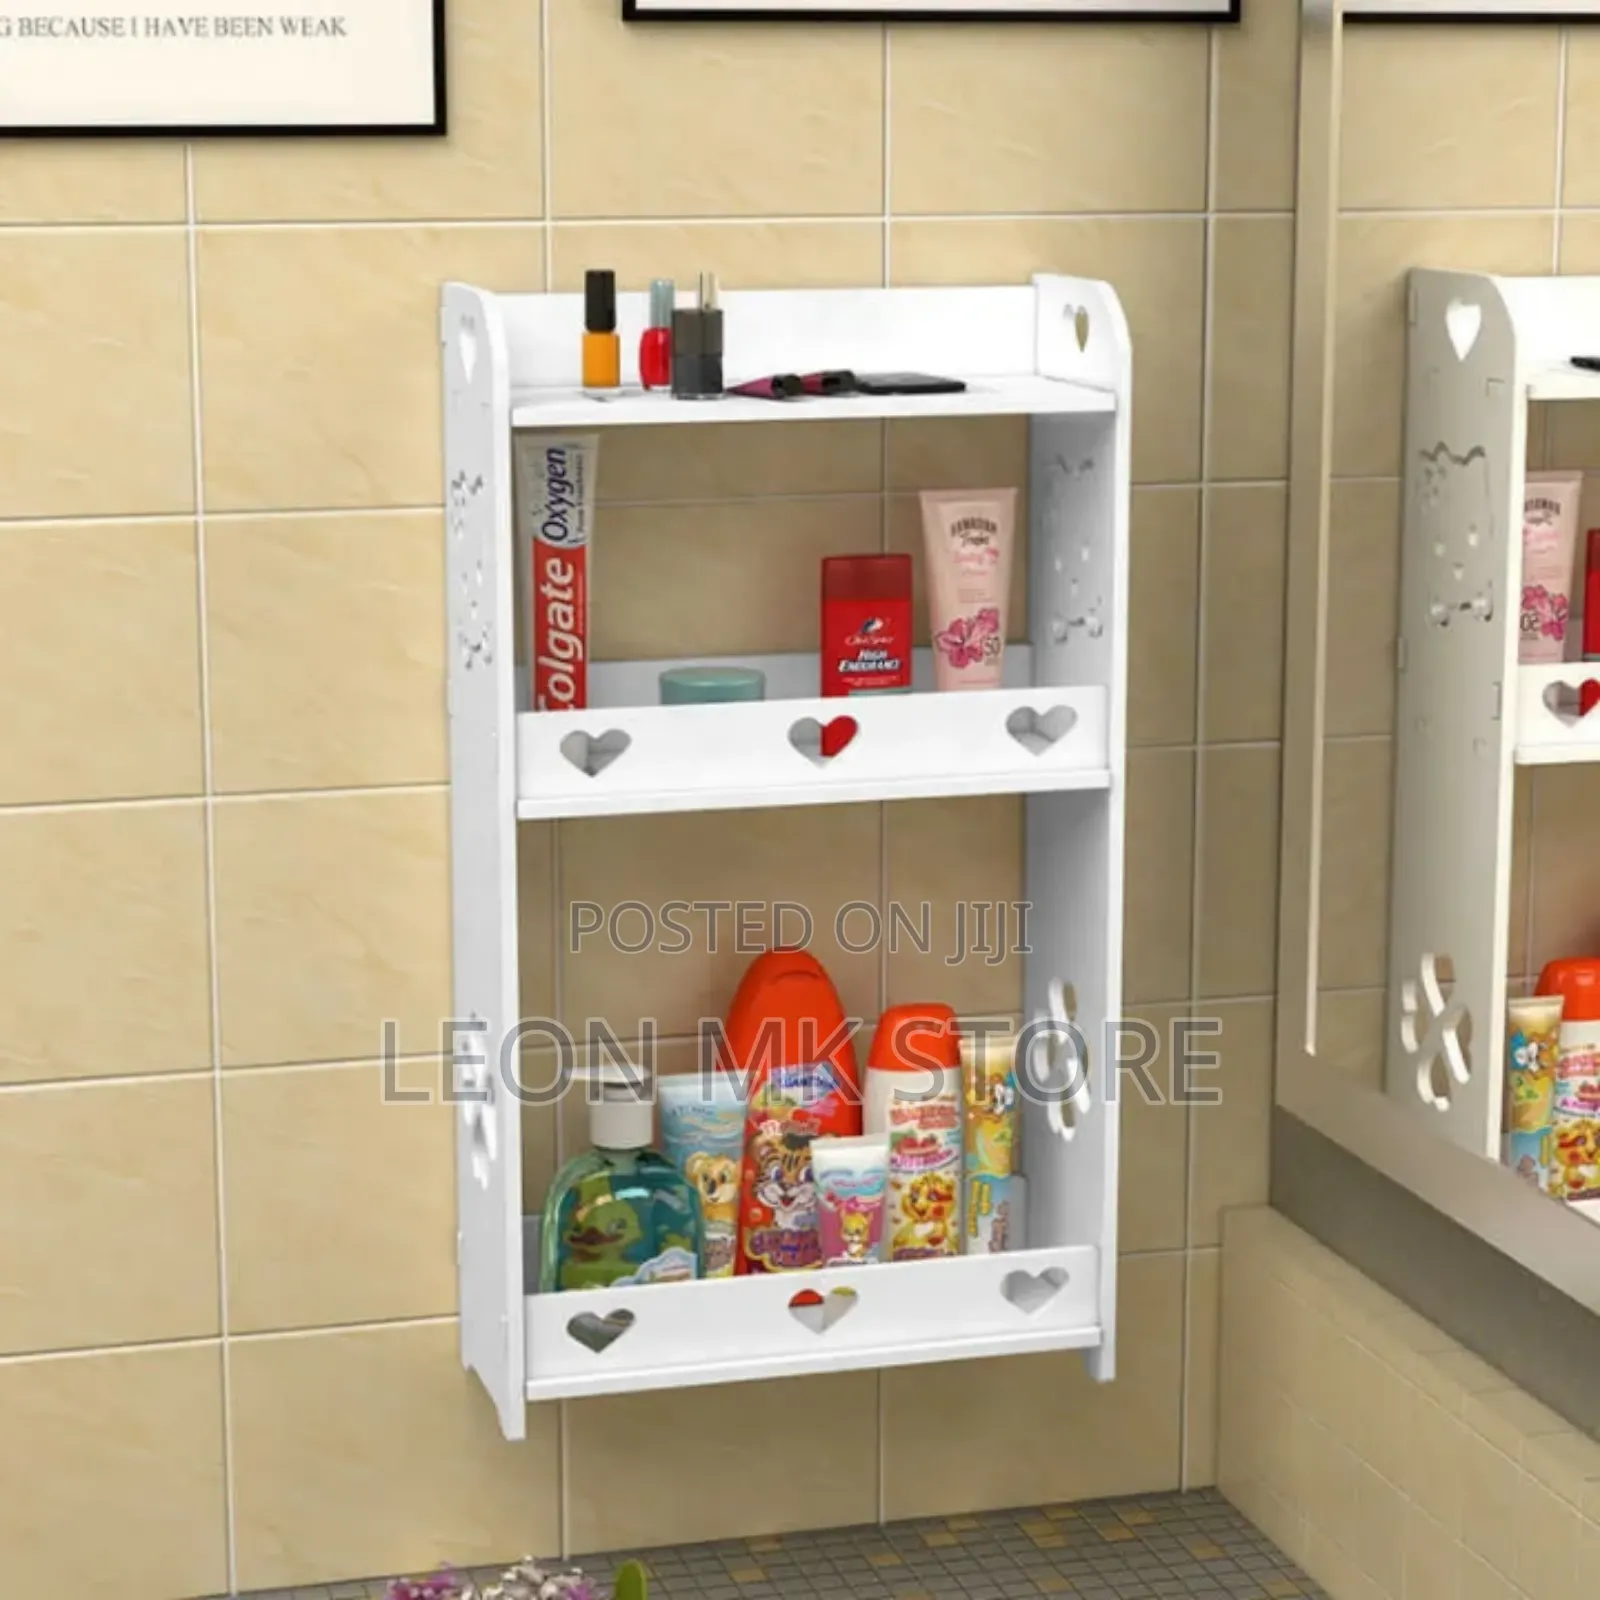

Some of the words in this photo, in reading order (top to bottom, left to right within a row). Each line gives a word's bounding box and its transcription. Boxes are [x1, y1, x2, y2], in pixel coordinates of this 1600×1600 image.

[18, 15, 126, 38] BECAUSE
[131, 15, 138, 38] I
[144, 15, 209, 38] HAVE
[214, 15, 273, 38] BEEN
[280, 15, 348, 37] WEAK
[541, 448, 575, 541] Oxygen
